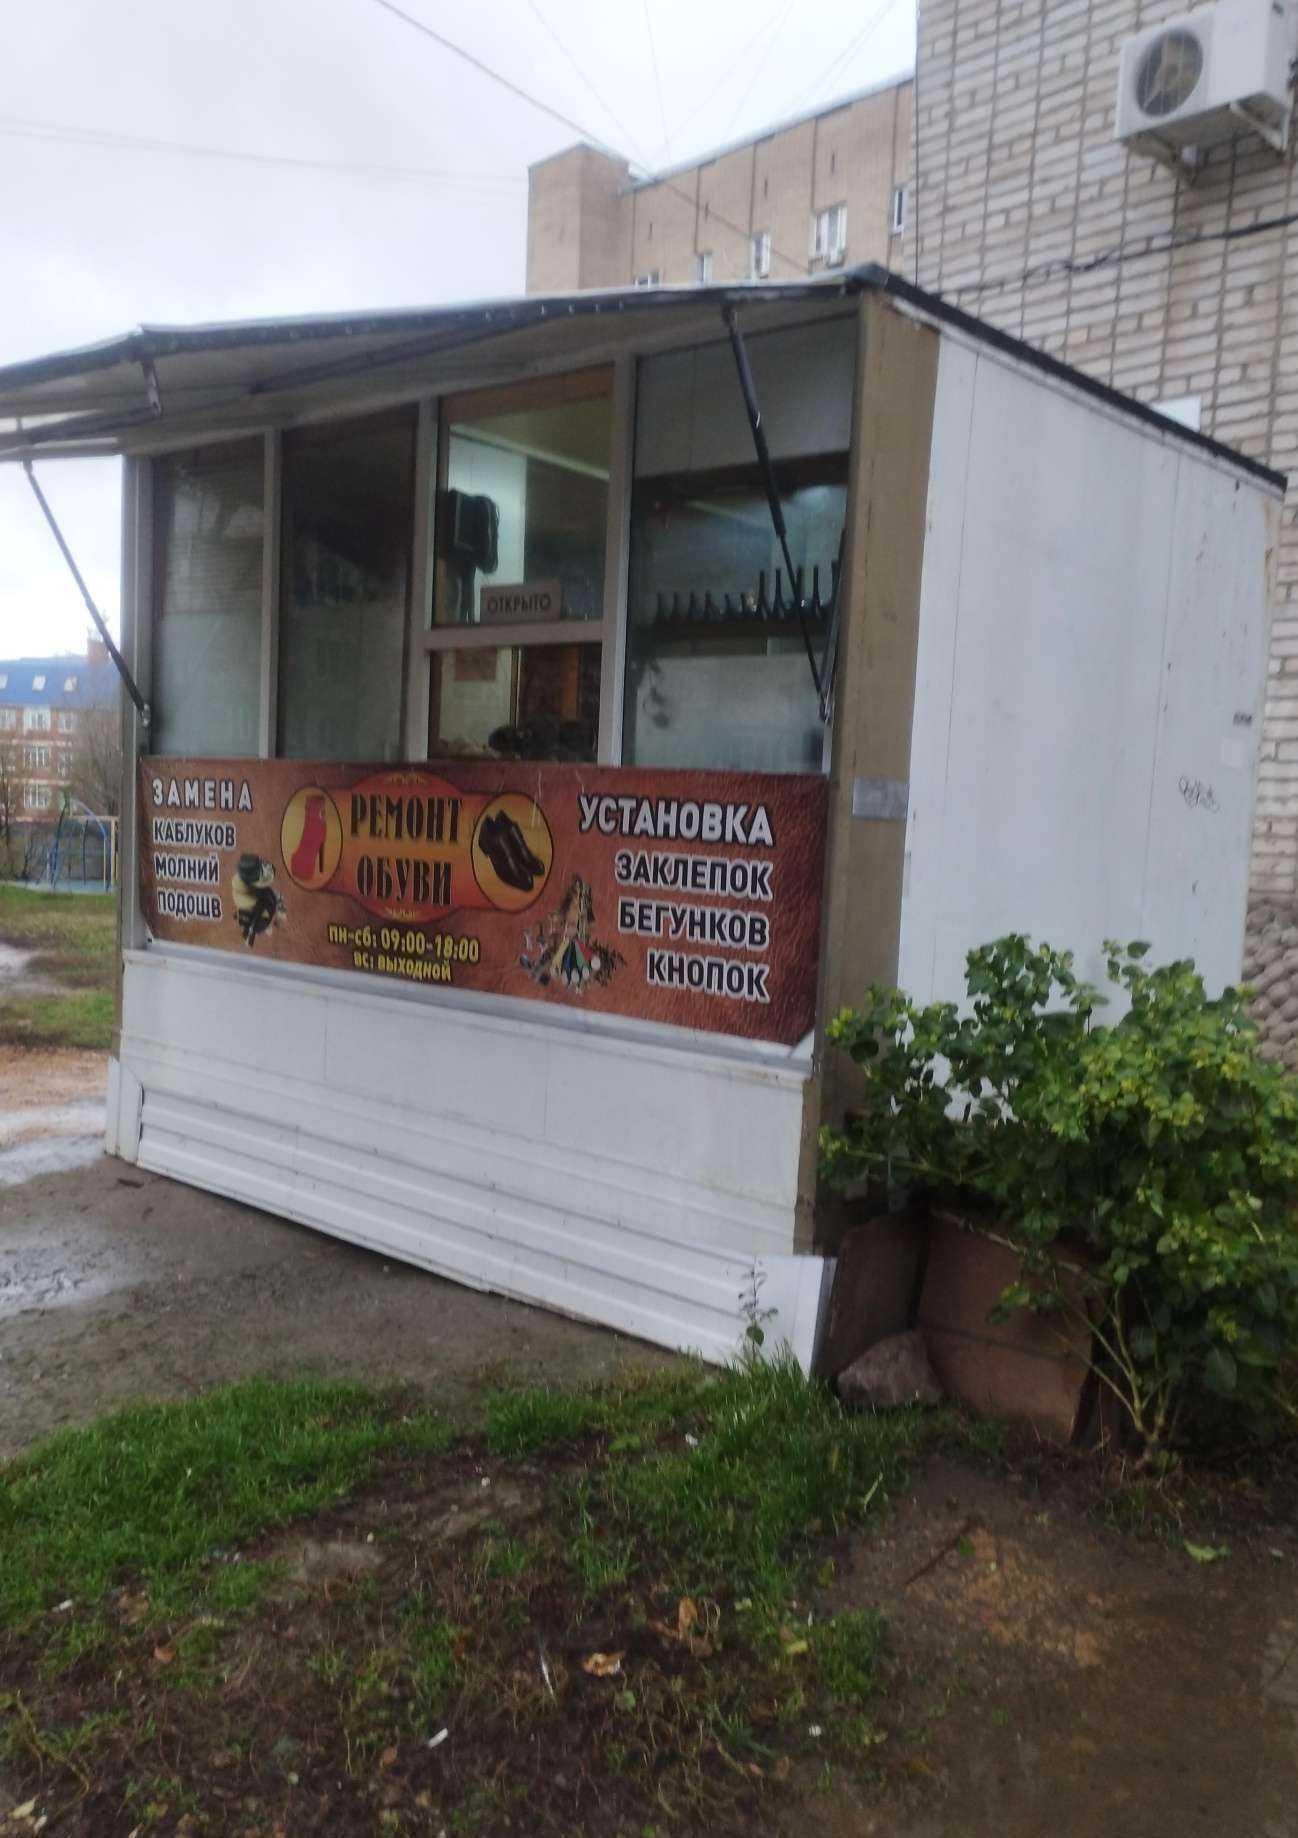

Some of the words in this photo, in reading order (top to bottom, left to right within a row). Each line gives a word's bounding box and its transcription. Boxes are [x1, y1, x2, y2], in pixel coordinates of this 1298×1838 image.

[487, 593, 551, 614] ОТКРЫТО
[152, 777, 253, 811] ЗАМЕНА
[153, 818, 236, 848] КАБЛУКОВ
[351, 793, 463, 842] РЕМОНТ
[579, 795, 774, 846] УСТАНОВКА
[154, 854, 219, 885] МОЛНИЙ
[356, 855, 452, 907] ОБУВИ
[615, 850, 773, 900] ЗАКЛЕПОК
[158, 889, 223, 919] ПОДОШВ
[618, 896, 770, 952] БЕГУНКОВ
[381, 926, 480, 962] 09:00-18:00
[647, 948, 770, 1004] КНОПОК
